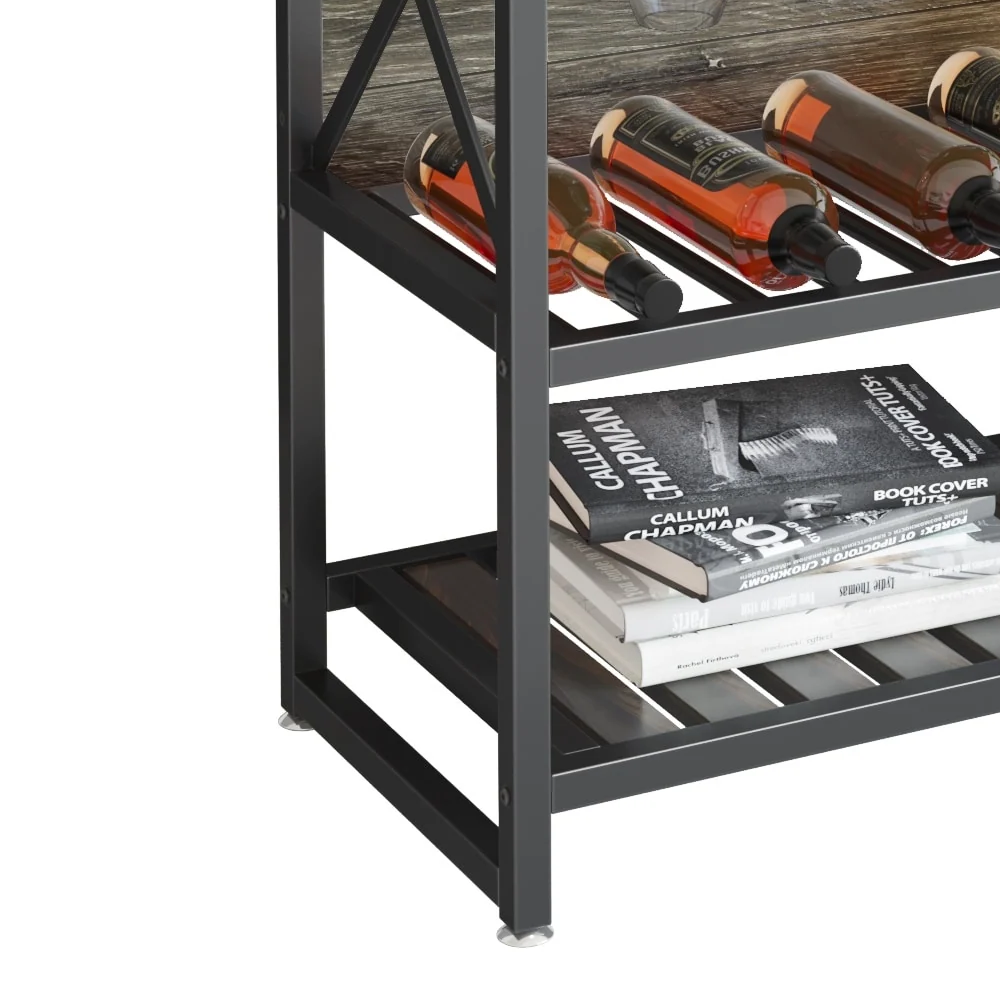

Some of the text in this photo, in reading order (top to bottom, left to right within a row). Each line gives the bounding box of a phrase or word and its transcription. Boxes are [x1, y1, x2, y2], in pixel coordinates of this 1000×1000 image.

[860, 374, 900, 408] TUTS+
[888, 405, 935, 441] COVER
[556, 429, 624, 491] CALLUM
[579, 406, 684, 501] CHAPMAN
[873, 477, 988, 501] BOOK COVER
[902, 493, 958, 507] TUTS+
[624, 516, 754, 541] CHAPMAN
[650, 506, 729, 526] CALLUM
[920, 515, 968, 536] FOREX:
[833, 536, 897, 561] ПРОСТОГО
[739, 561, 818, 591] СЛОЖНОМУ
[839, 575, 895, 598] Lydie Thomas
[672, 608, 710, 634] Paris
